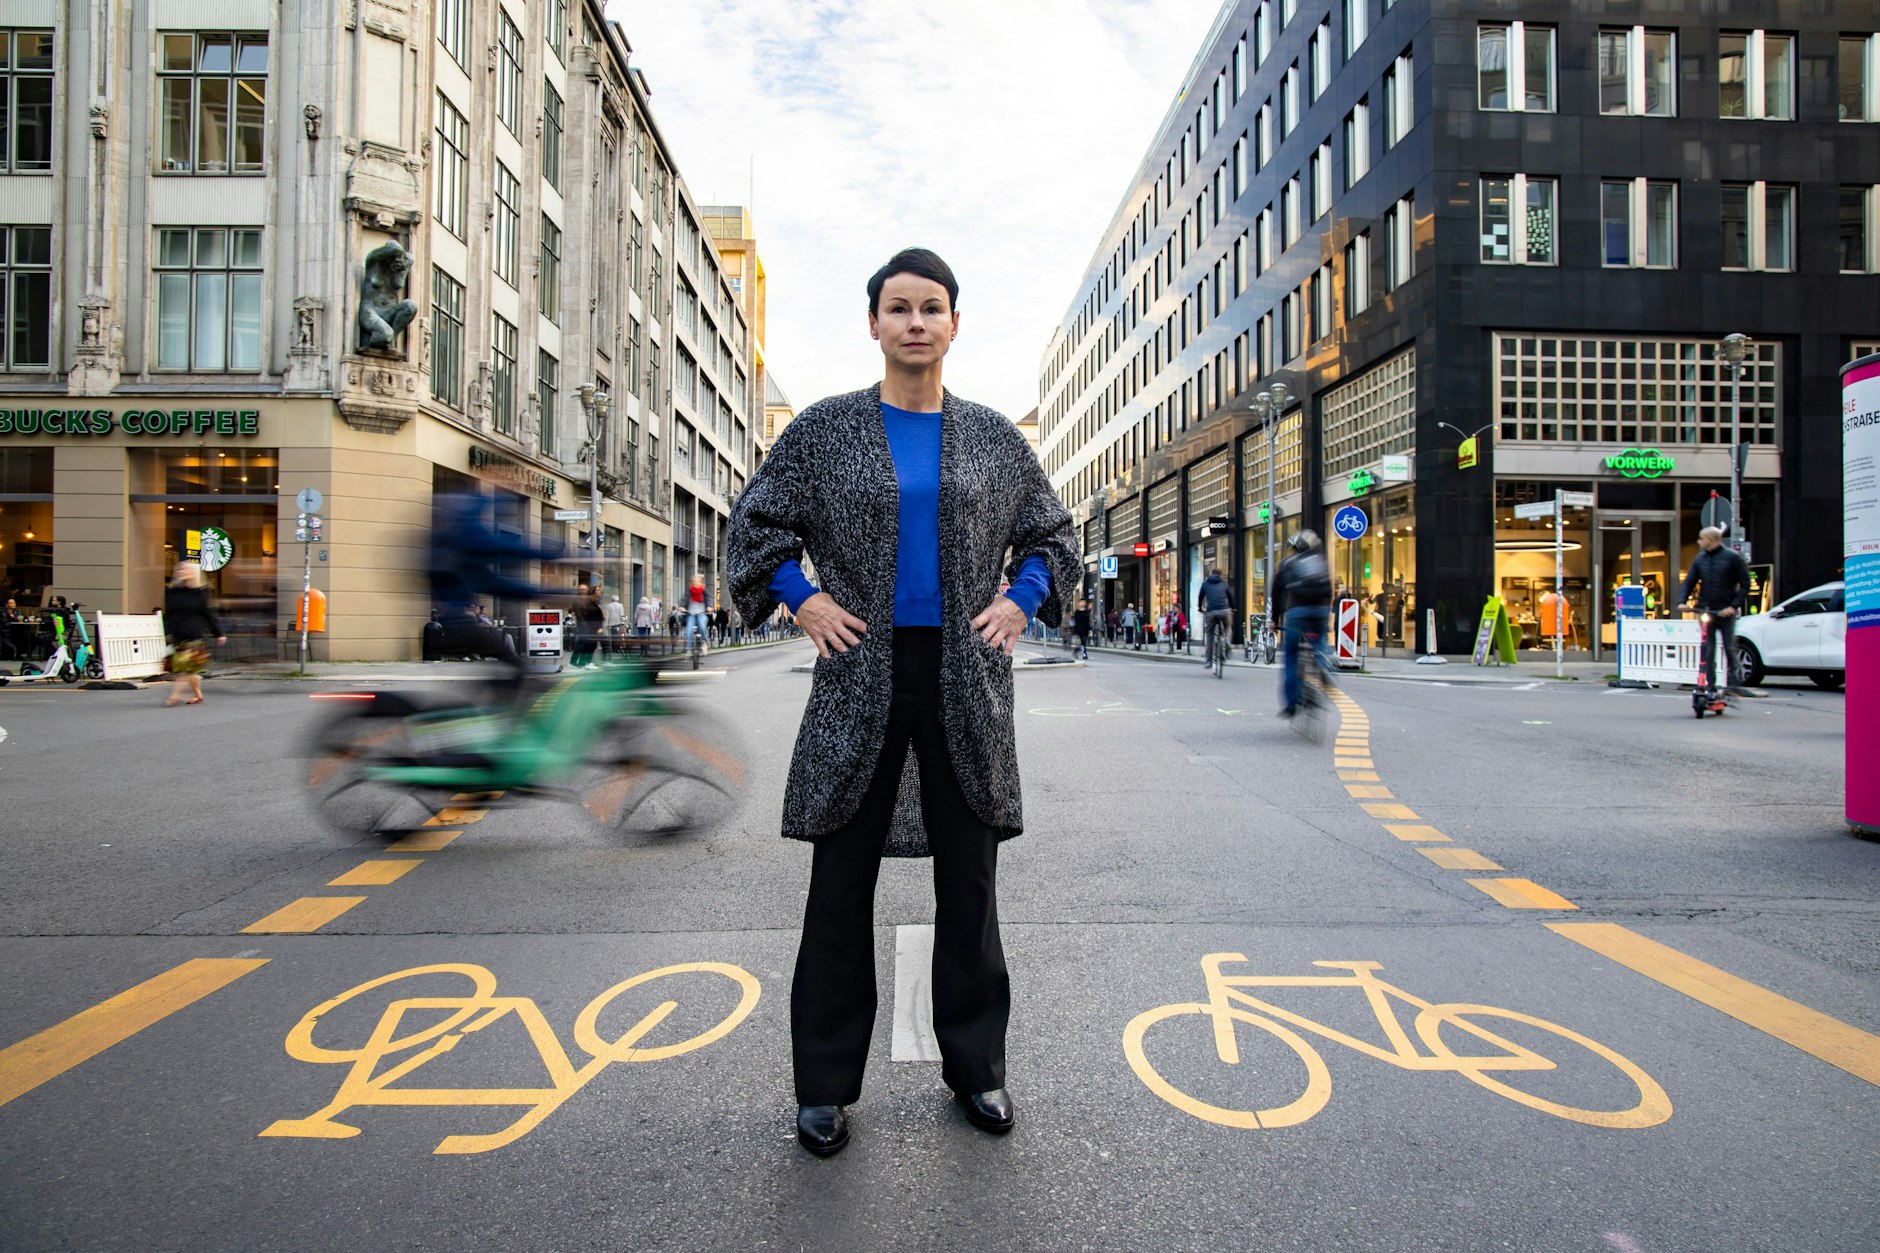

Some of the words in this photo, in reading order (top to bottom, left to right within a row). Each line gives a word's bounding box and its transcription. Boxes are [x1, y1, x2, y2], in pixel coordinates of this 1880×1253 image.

[120, 410, 258, 434] COFFEE
[1605, 455, 1676, 470] VORWERK
[1103, 557, 1116, 572] U
